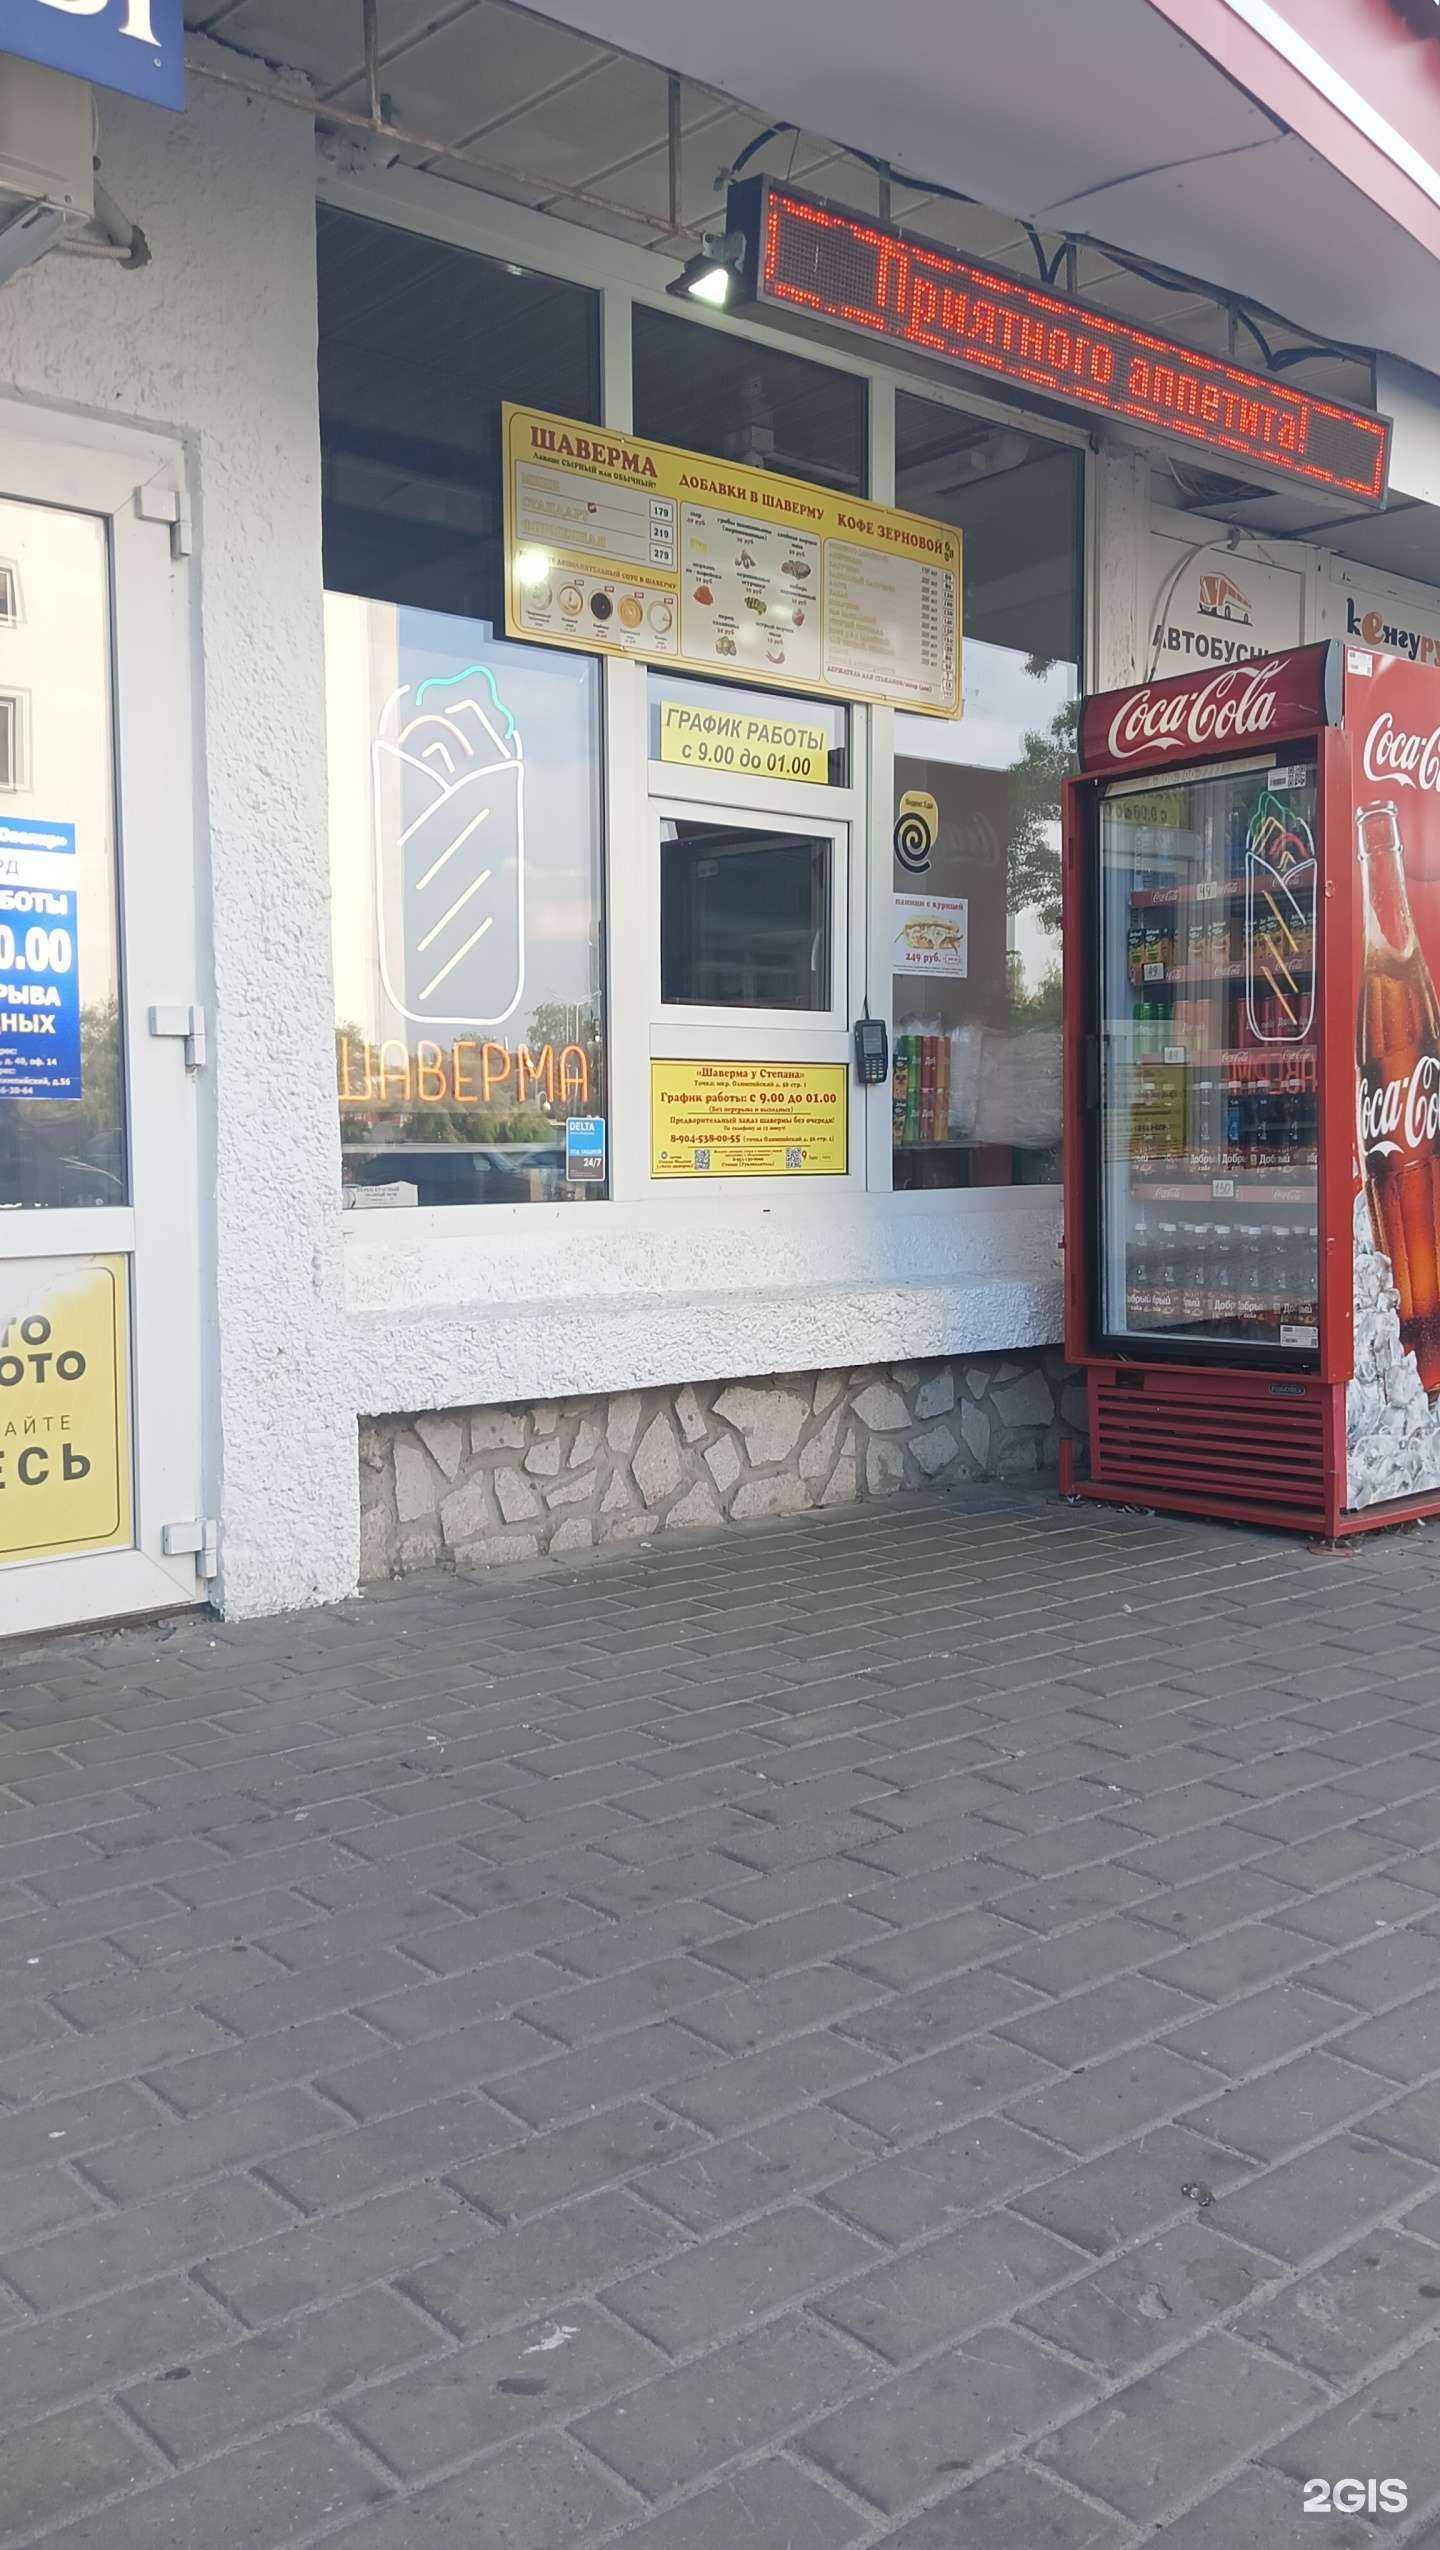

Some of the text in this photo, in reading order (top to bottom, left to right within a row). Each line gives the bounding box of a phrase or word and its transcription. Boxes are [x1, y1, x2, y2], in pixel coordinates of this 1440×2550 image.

[875, 240, 1308, 455] Приятного аппетита!
[530, 426, 657, 478] ШАВЕРМА
[562, 458, 597, 475] СЫРНЫЙ
[679, 473, 824, 520] ДОБАВКИ В ШАВЕРМУ
[653, 506, 669, 517] 179
[653, 527, 669, 539] 219
[837, 513, 943, 555] КОФЕ ЗЕРНОВОЙ
[653, 549, 669, 560] 279
[1152, 624, 1271, 662] АВТОБУСН
[1108, 657, 1292, 759] Coca-Cola
[666, 707, 824, 750] ГРАФИК РАБОТЫ
[682, 742, 811, 776] с 9.00 до 01.00
[895, 898, 924, 907] панини
[932, 902, 963, 911] курицей
[905, 952, 922, 963] 249
[923, 954, 941, 965] руб.
[0, 1013, 56, 1034] НЫХ
[697, 1068, 804, 1079] «Шаверма у Степана»
[661, 1092, 702, 1104] График
[706, 1091, 747, 1104] работы:
[760, 1093, 784, 1104] 9.00
[788, 1094, 802, 1104] до
[806, 1093, 836, 1104] 01.00
[570, 1121, 595, 1131] DELTA
[760, 1117, 792, 1125] шавермы
[670, 1134, 741, 1144] 8-904-538-00-55
[583, 1157, 602, 1168] 24/7
[4, 1415, 71, 1438] АЙТЕ
[0, 1443, 91, 1489] СЬ
